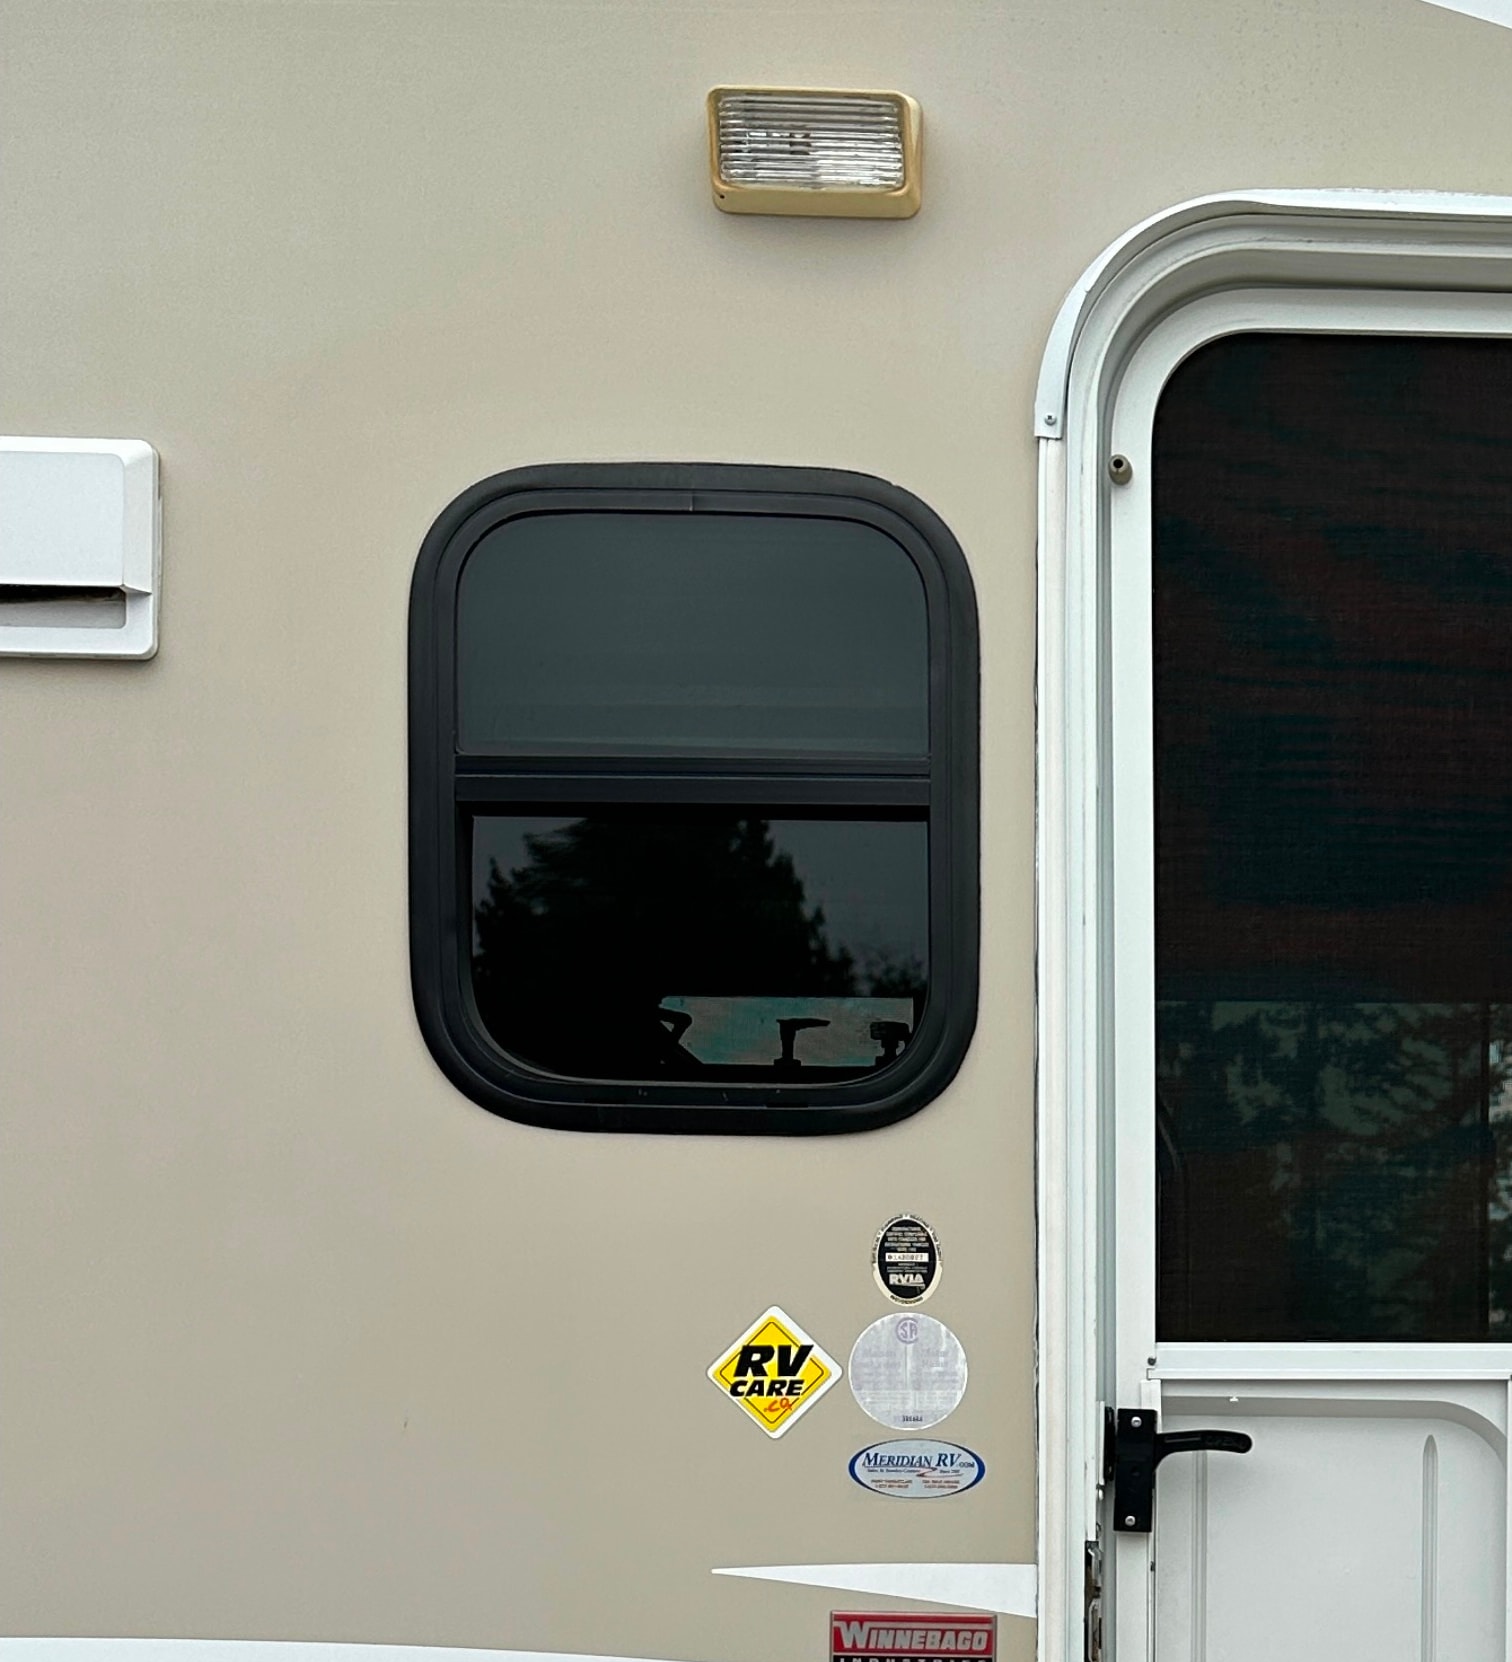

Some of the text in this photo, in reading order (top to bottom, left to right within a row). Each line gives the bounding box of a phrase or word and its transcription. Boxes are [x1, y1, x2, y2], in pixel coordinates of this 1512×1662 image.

[889, 1273, 925, 1286] RVIA
[733, 1344, 814, 1377] RV
[729, 1379, 804, 1397] CARE
[863, 1453, 934, 1468] MERIDIAN
[838, 1621, 989, 1650] WINNEBAGO
